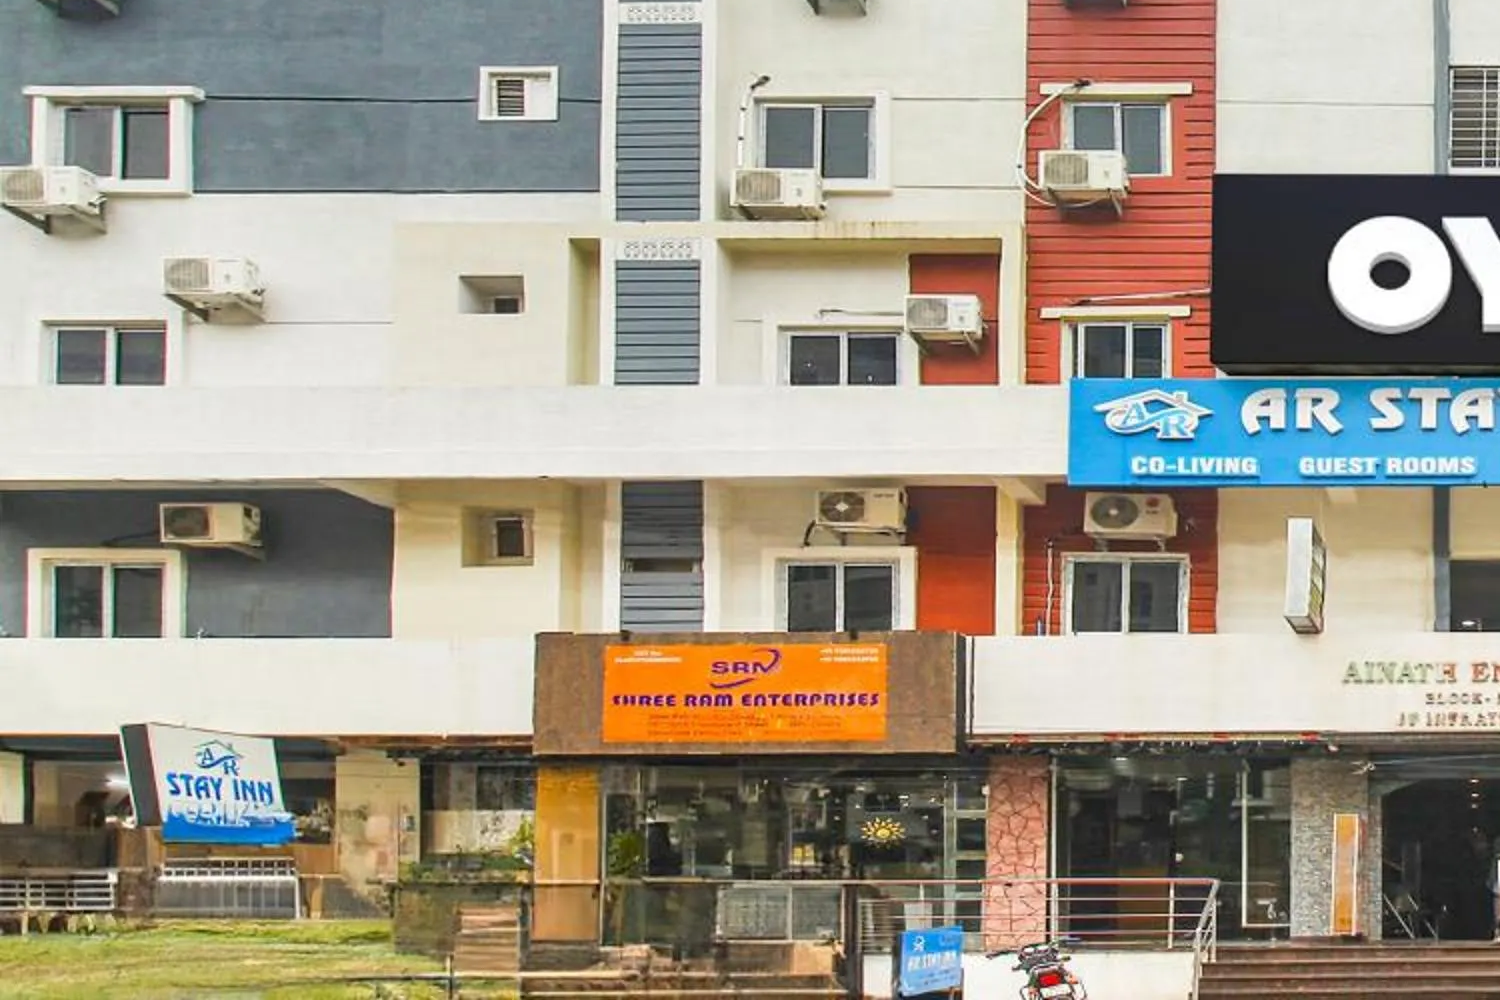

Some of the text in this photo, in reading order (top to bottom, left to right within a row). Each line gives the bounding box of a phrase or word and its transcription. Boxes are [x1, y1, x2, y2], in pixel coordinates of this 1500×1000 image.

[1240, 387, 1345, 437] AR
[1131, 456, 1258, 476] CO-LIVING
[1300, 456, 1476, 475] GUEST ROOMS
[683, 693, 733, 707] RAM
[742, 692, 880, 707] ENTERPRISES
[165, 771, 274, 806] STAY INN
